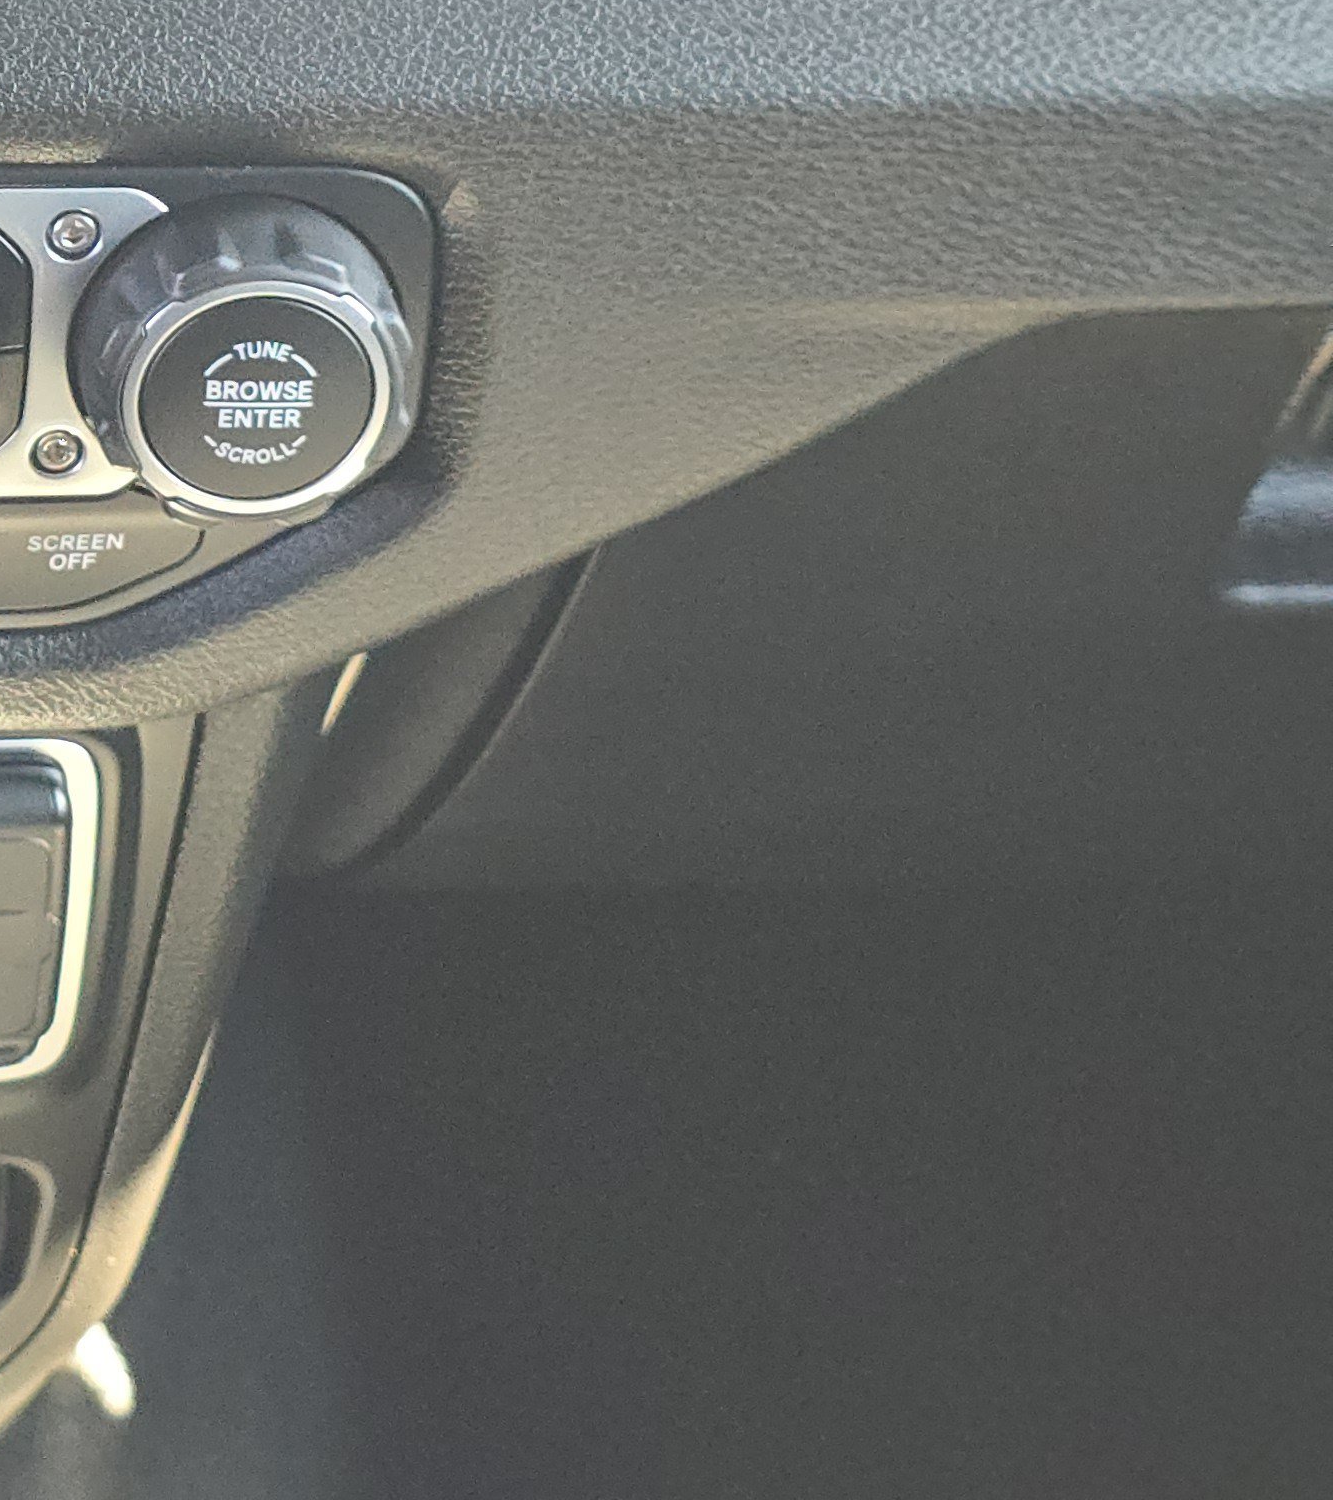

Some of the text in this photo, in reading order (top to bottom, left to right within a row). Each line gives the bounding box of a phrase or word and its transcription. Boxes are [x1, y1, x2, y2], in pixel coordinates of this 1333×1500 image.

[234, 341, 292, 361] TUNE
[206, 380, 312, 400] BROWSE
[218, 408, 300, 428] ENTER
[215, 443, 296, 464] SCROLL
[27, 532, 125, 552] SCREEN
[48, 551, 98, 572] OFF
